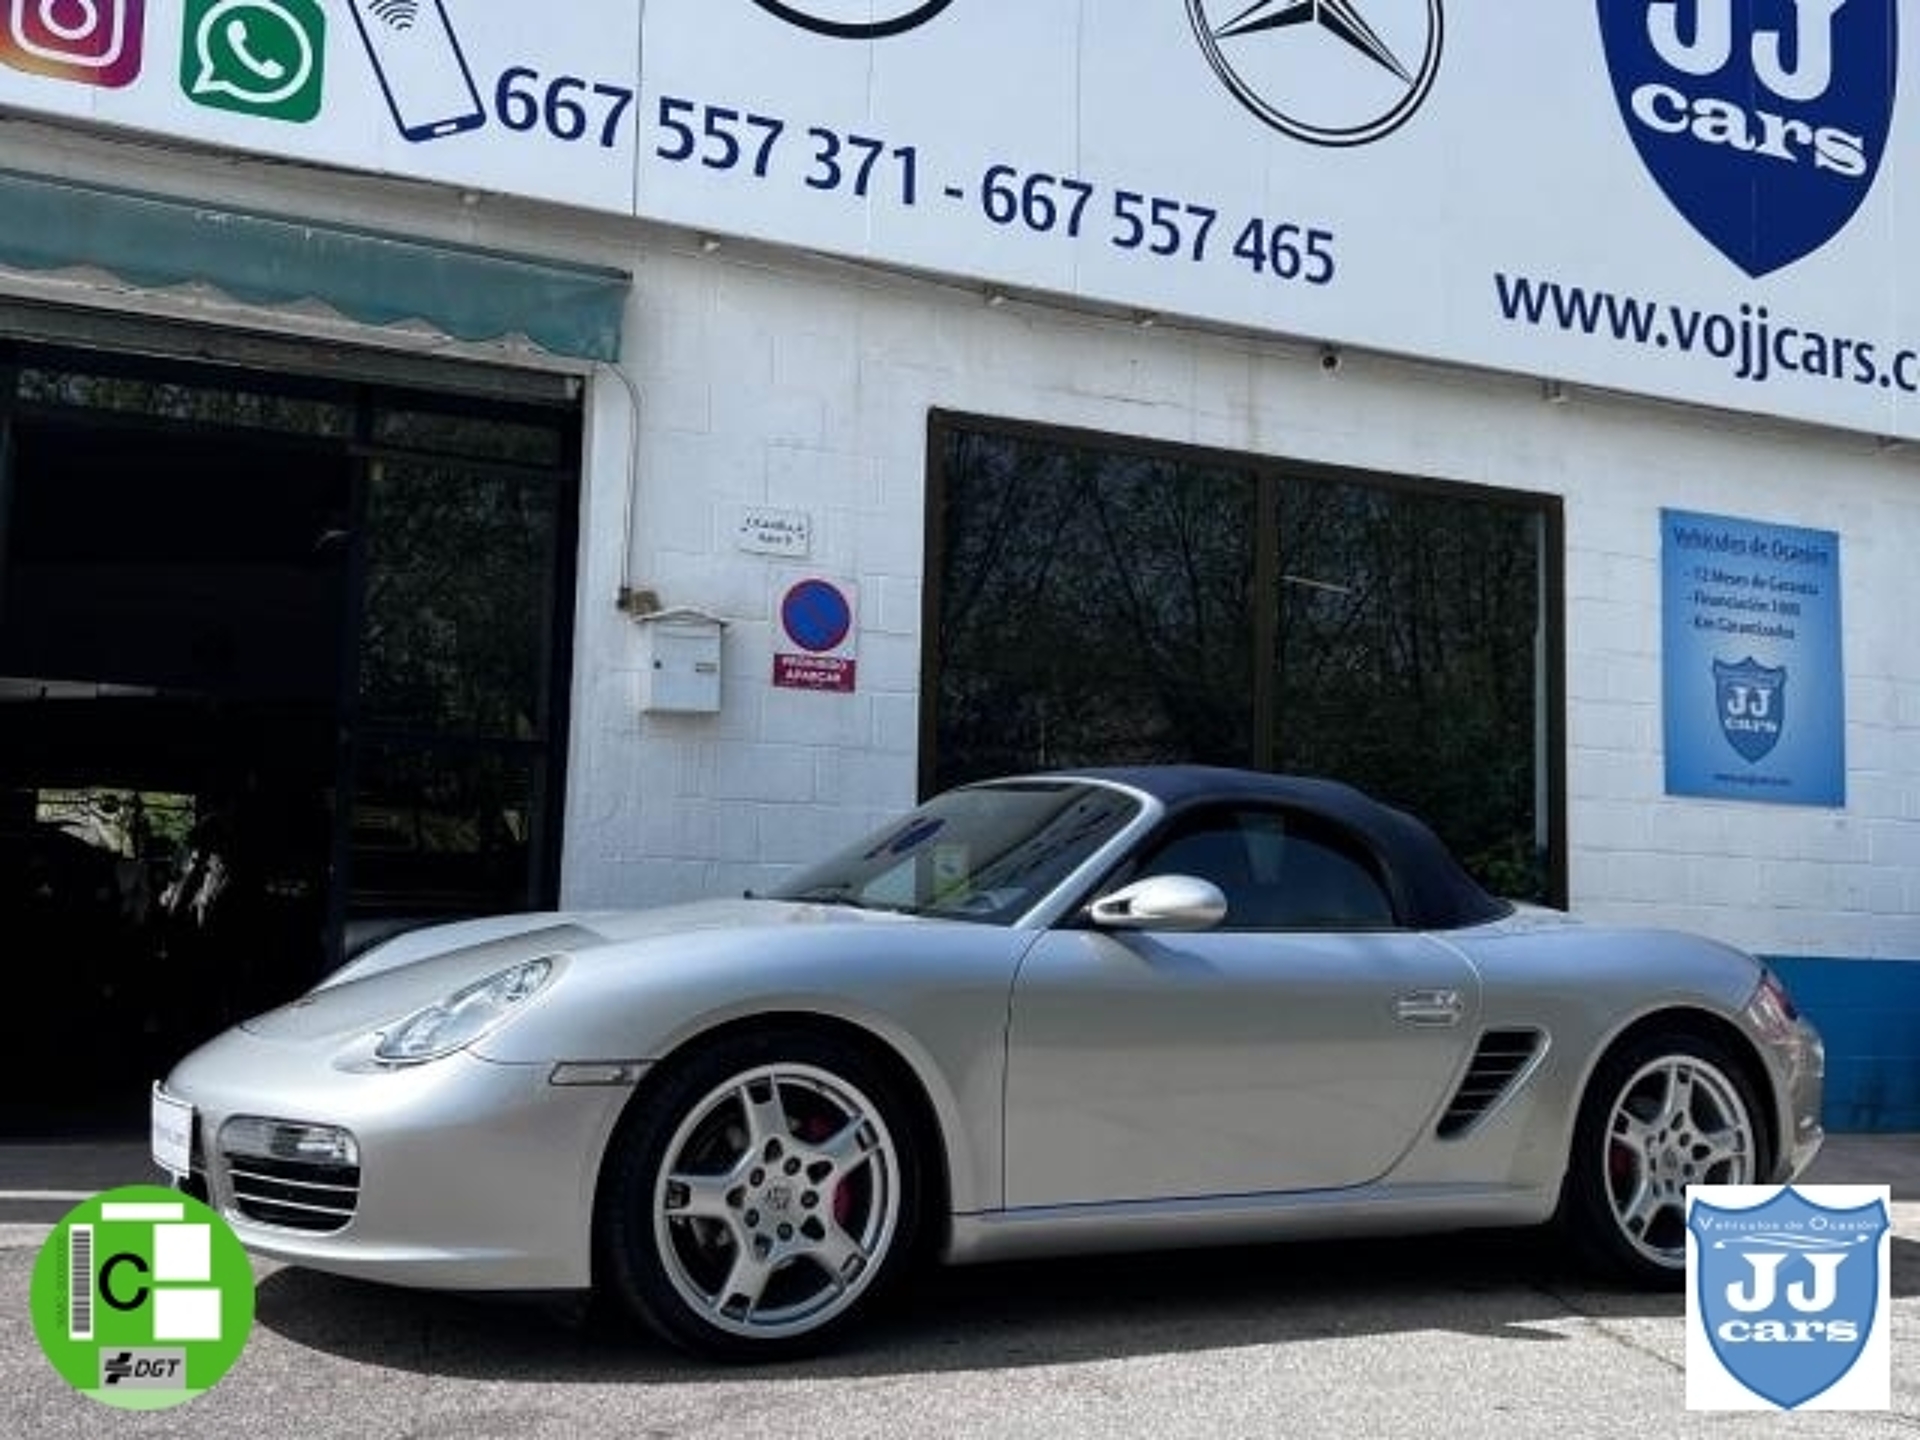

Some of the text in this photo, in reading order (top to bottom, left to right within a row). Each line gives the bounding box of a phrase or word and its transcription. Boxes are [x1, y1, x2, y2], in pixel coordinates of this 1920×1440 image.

[1631, 83, 1867, 178] cars
[495, 66, 1335, 286] 667 557 371 - 667 557 465
[784, 667, 842, 682] APARCAR
[1727, 686, 1772, 718] JJ
